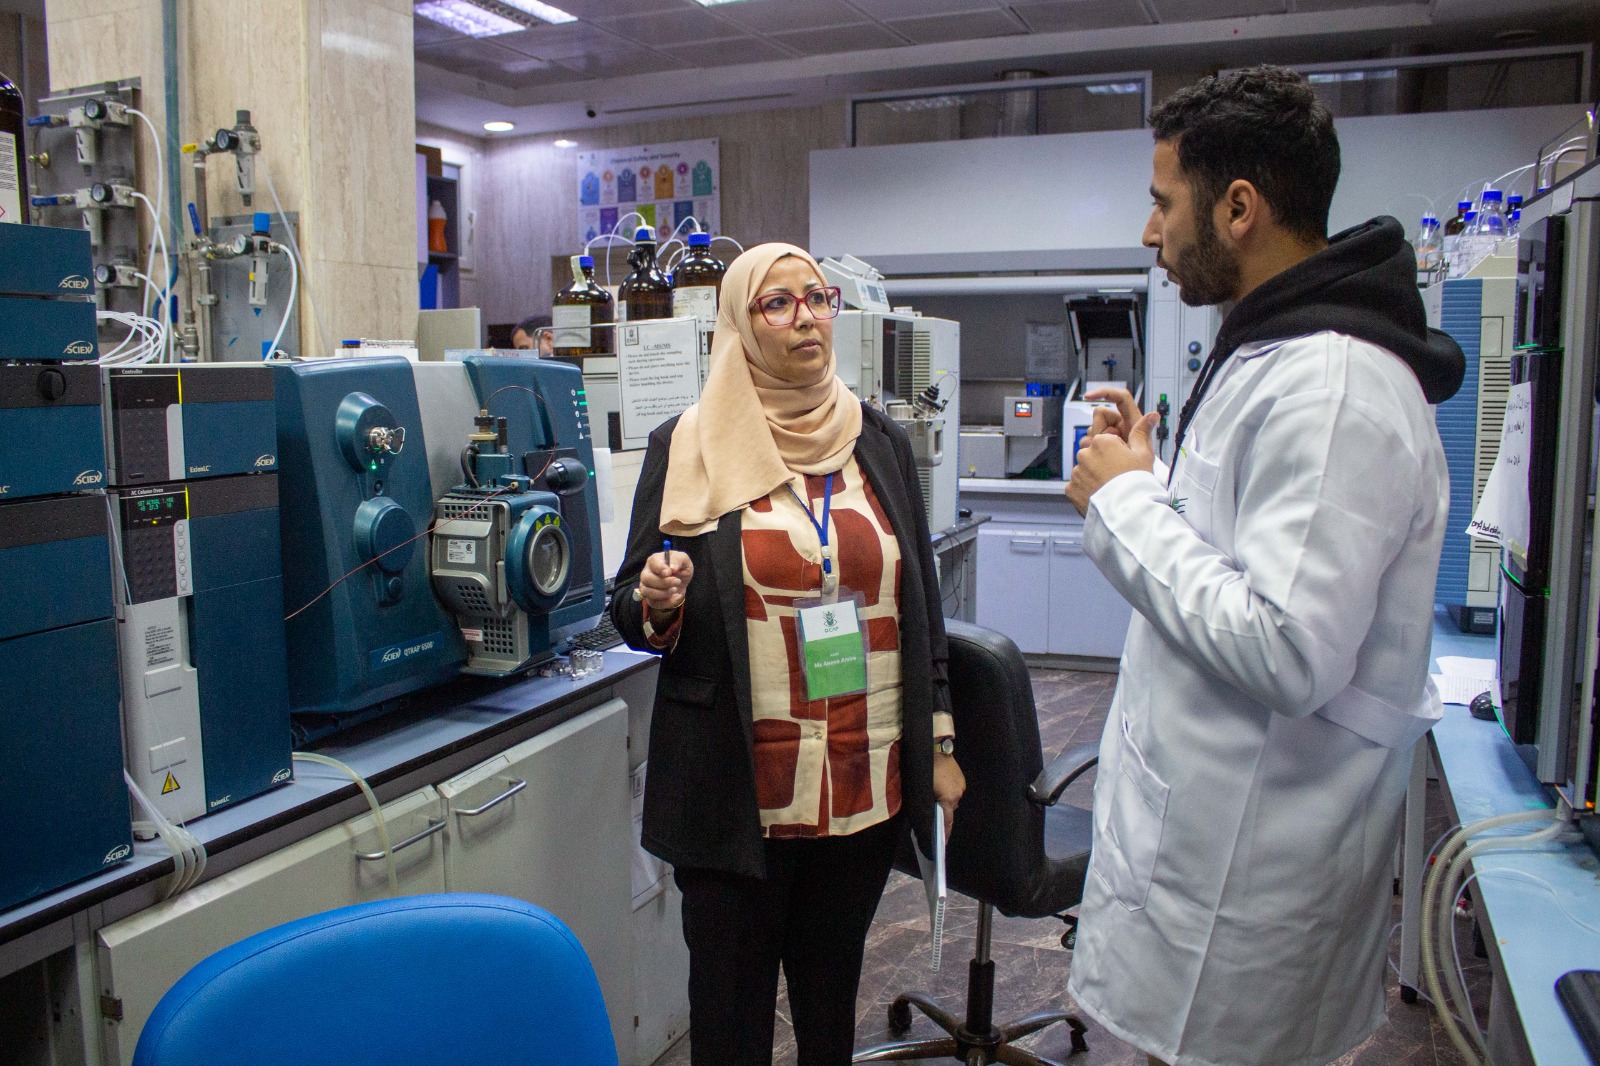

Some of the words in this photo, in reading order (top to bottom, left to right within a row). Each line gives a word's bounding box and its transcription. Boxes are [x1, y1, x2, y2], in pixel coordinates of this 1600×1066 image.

[60, 277, 88, 289] SCIEX
[65, 343, 92, 354] SCIEX
[255, 456, 275, 467] SCIEX
[75, 472, 101, 485] SCIEX
[382, 650, 401, 662] SCIEX
[272, 770, 291, 783] SCIEX
[104, 847, 130, 864] SCIEX
